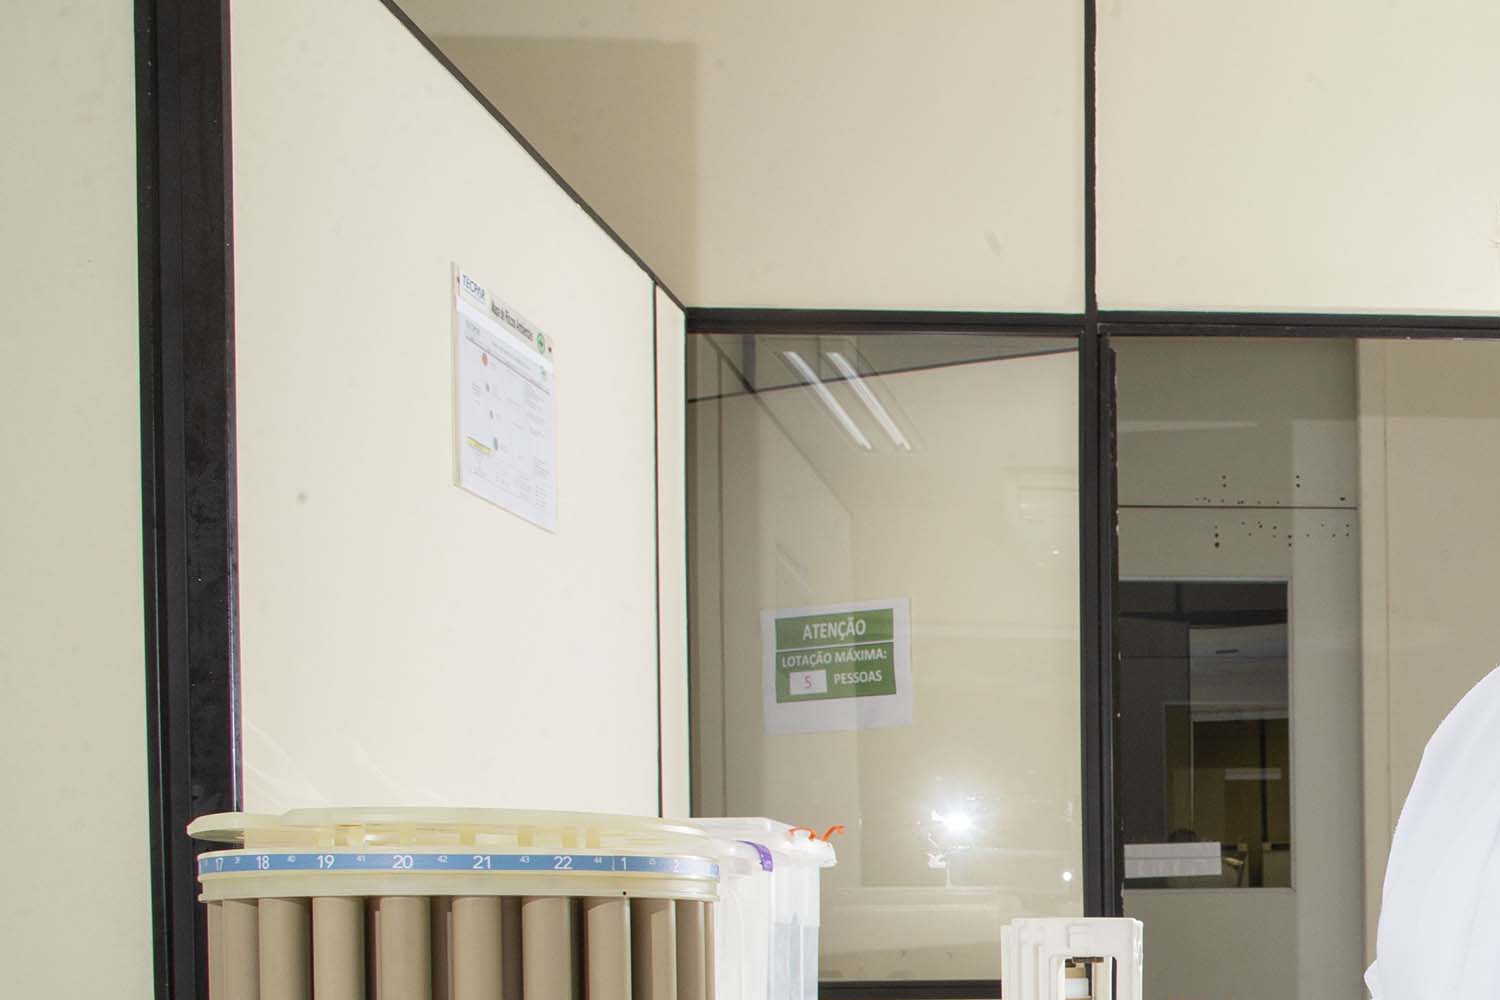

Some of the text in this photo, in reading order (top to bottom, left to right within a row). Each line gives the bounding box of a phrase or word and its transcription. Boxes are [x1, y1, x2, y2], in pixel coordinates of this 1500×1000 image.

[802, 617, 866, 641] ATENÇÃO
[782, 647, 888, 668] LOTAÇÃO MÁXIMA:
[833, 670, 883, 685] PESSOAS
[256, 855, 270, 870] 18
[318, 855, 335, 869] 19
[392, 855, 414, 869] 20
[473, 855, 492, 869] 21
[554, 855, 573, 870] 22
[621, 856, 628, 870] 1
